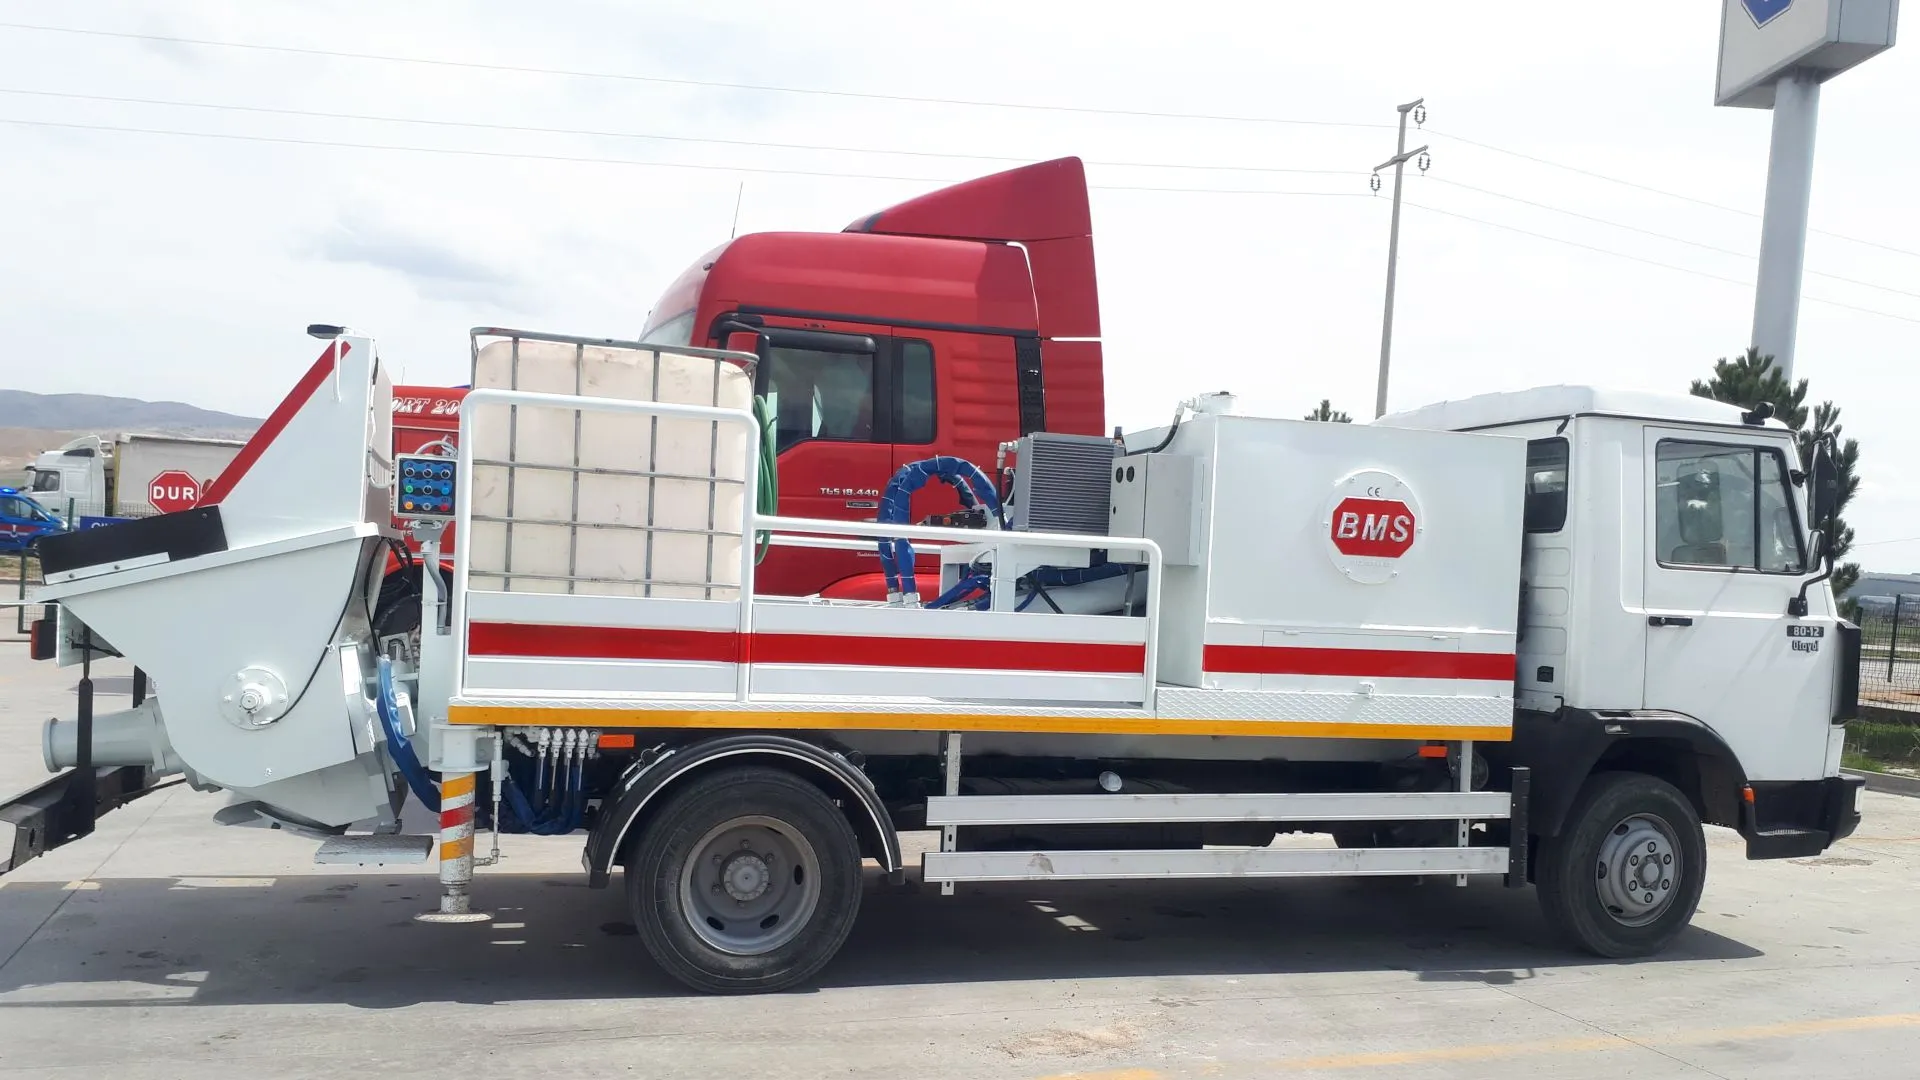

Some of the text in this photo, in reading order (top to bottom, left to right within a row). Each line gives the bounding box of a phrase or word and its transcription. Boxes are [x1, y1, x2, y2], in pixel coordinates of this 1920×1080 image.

[152, 486, 195, 501] DUR
[1336, 511, 1411, 543] BMS
[1793, 626, 1820, 637] 80-12
